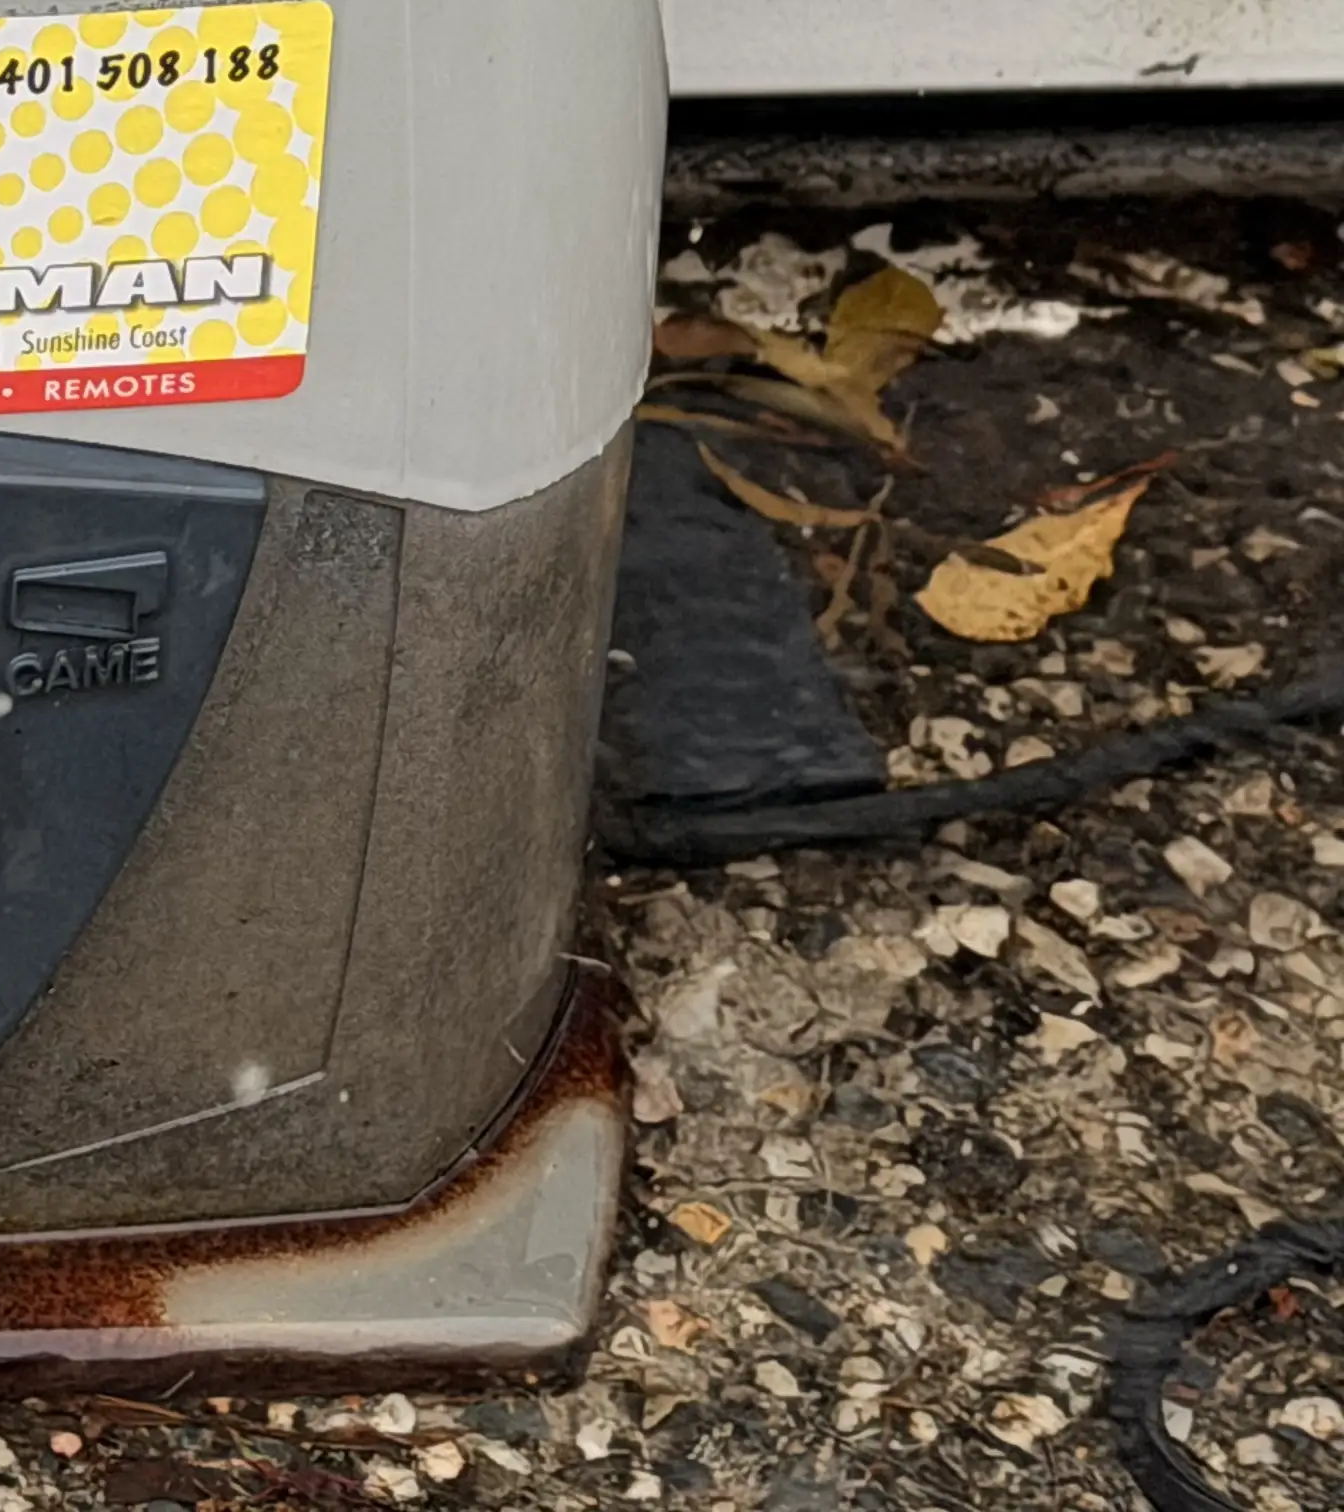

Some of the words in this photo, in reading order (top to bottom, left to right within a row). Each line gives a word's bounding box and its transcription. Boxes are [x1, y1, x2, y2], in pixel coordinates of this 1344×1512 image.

[97, 50, 181, 90] 508
[202, 43, 281, 84] 188
[20, 328, 122, 355] Sunshine
[129, 324, 187, 350] Coast
[43, 370, 196, 401] REMOTES
